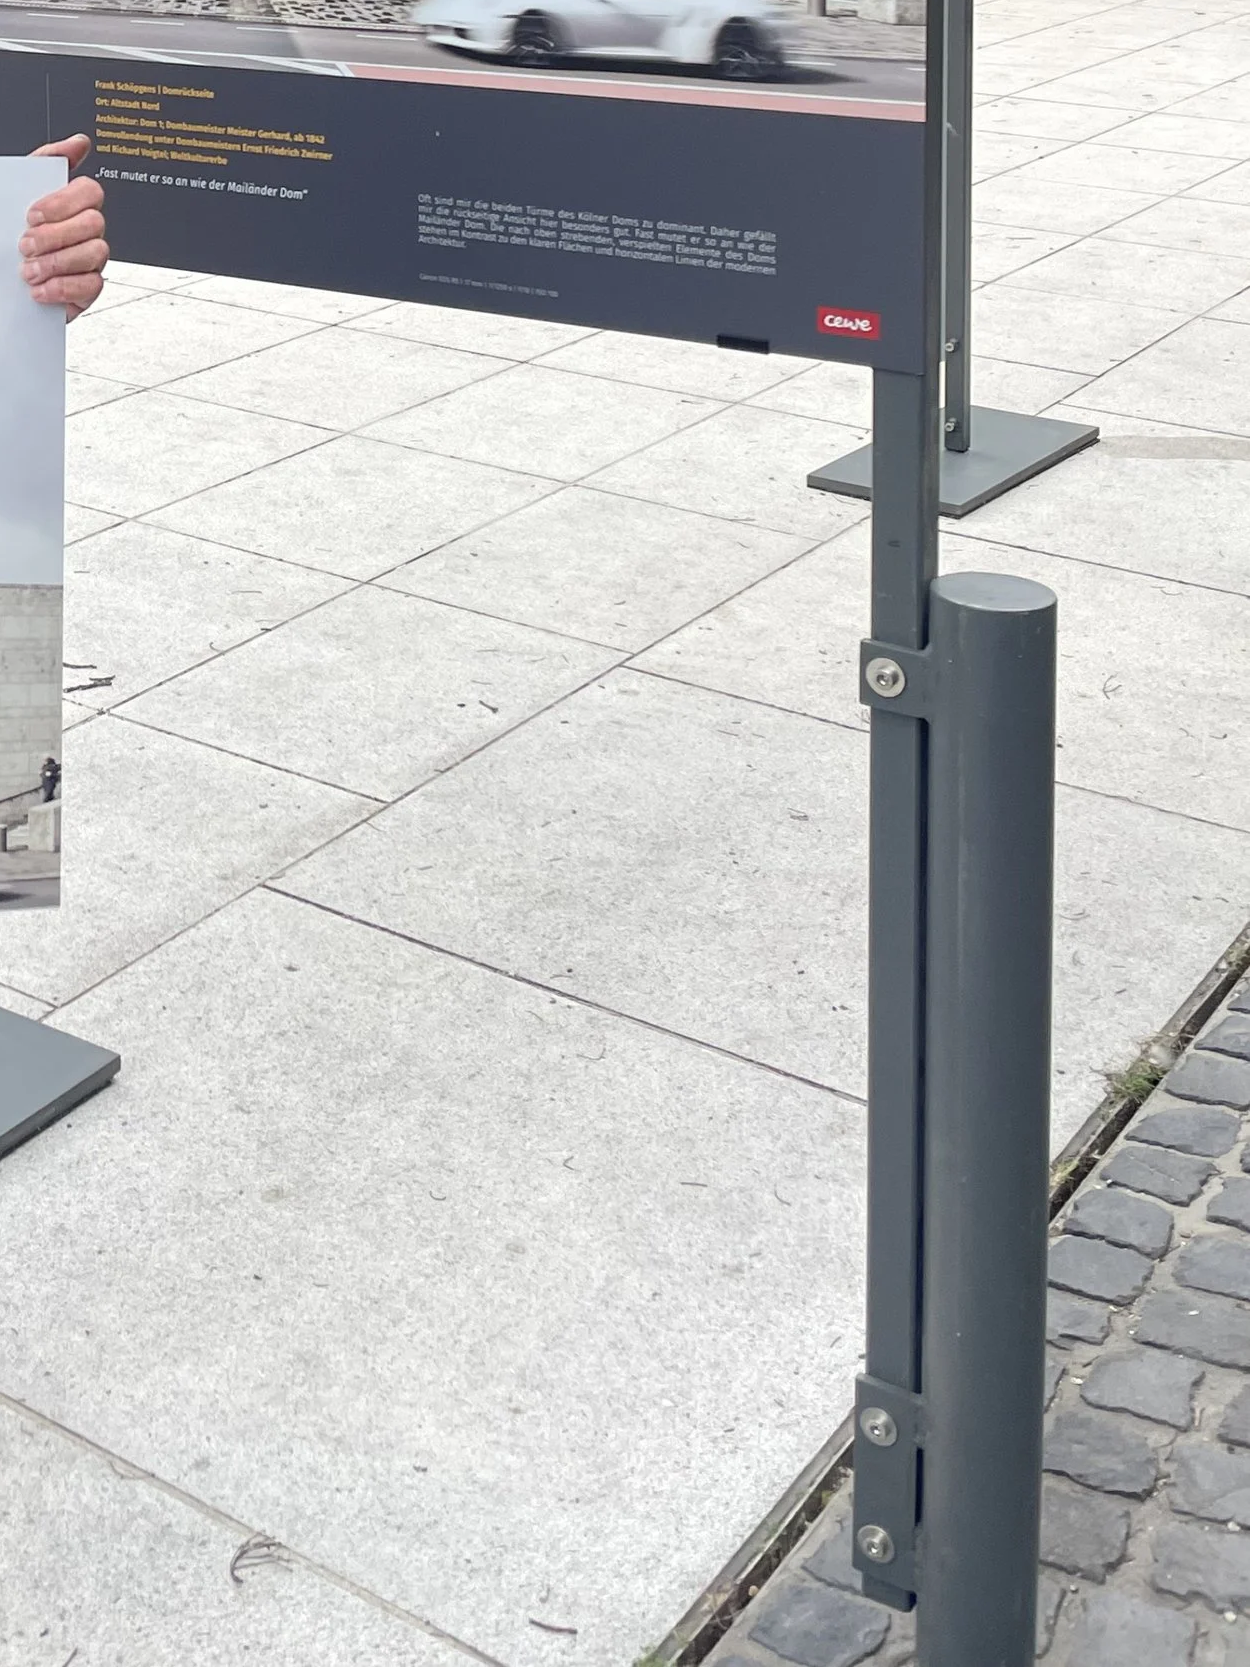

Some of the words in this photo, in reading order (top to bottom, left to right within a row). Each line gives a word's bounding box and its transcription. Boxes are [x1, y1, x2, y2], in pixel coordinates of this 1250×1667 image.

[95, 80, 116, 90] Frank
[162, 86, 215, 99] Domrückseite
[95, 97, 110, 106] Ort:
[110, 99, 141, 109] Altstadt
[141, 102, 160, 111] Nord
[95, 114, 139, 126] Architektur:
[140, 118, 157, 127] Dom
[166, 120, 226, 134] Dombaumeister
[227, 126, 256, 137] Meister
[257, 129, 292, 142] Gerhard,
[293, 133, 304, 142] ab
[95, 128, 153, 144] Domvollendung
[154, 135, 175, 145] unter
[176, 136, 241, 151] Dombaumeistern
[242, 143, 263, 153] Ernst
[264, 145, 300, 157] Friedrich
[96, 144, 111, 153] und
[112, 144, 140, 156] Richard
[170, 150, 228, 165] Weltkulturerbe
[121, 170, 148, 183] mutet
[150, 174, 160, 183] er
[162, 176, 173, 185] so
[175, 177, 188, 186] an
[190, 177, 207, 189] wie
[208, 179, 226, 191] der
[227, 181, 276, 197] Mailänder
[418, 194, 431, 203] Oft
[434, 196, 454, 206] sind
[456, 199, 471, 207] mir
[474, 200, 489, 210] die
[492, 202, 523, 213] beiden
[526, 205, 555, 217] Türme
[557, 210, 575, 220] des
[578, 211, 609, 223] Kölner
[612, 215, 639, 227] Doms
[642, 220, 653, 228] zu
[710, 226, 740, 238] Daher
[743, 230, 776, 242] gefällt
[418, 205, 433, 213] mir
[435, 206, 450, 215] die
[453, 209, 500, 222] rückseitige
[503, 214, 537, 226] Ansicht
[540, 218, 558, 228] hier
[561, 220, 610, 234] besonders
[635, 228, 654, 239] Fast
[658, 233, 686, 243] mutet
[690, 237, 701, 245] er
[704, 238, 717, 246] so
[720, 240, 734, 248] an
[737, 242, 755, 250] wie
[758, 243, 776, 252] der
[418, 214, 461, 227] Mailänder
[490, 221, 505, 232] Die
[508, 226, 530, 235] nach
[534, 228, 557, 238] oben
[619, 239, 672, 252] verspielten
[676, 244, 721, 258] Elemente
[725, 250, 744, 261] des
[747, 252, 776, 265] Doms
[418, 225, 447, 236] stehen
[449, 229, 460, 237] im
[461, 230, 497, 242] Kontrast
[498, 235, 508, 243] zu
[510, 235, 528, 245] den
[529, 237, 557, 249] klaren
[558, 240, 594, 253] Flächen
[595, 246, 613, 256] und
[615, 248, 674, 263] horizontalen
[675, 255, 705, 267] Linien
[706, 258, 724, 269] der
[725, 262, 777, 275] modernen
[823, 314, 873, 332] cewe
